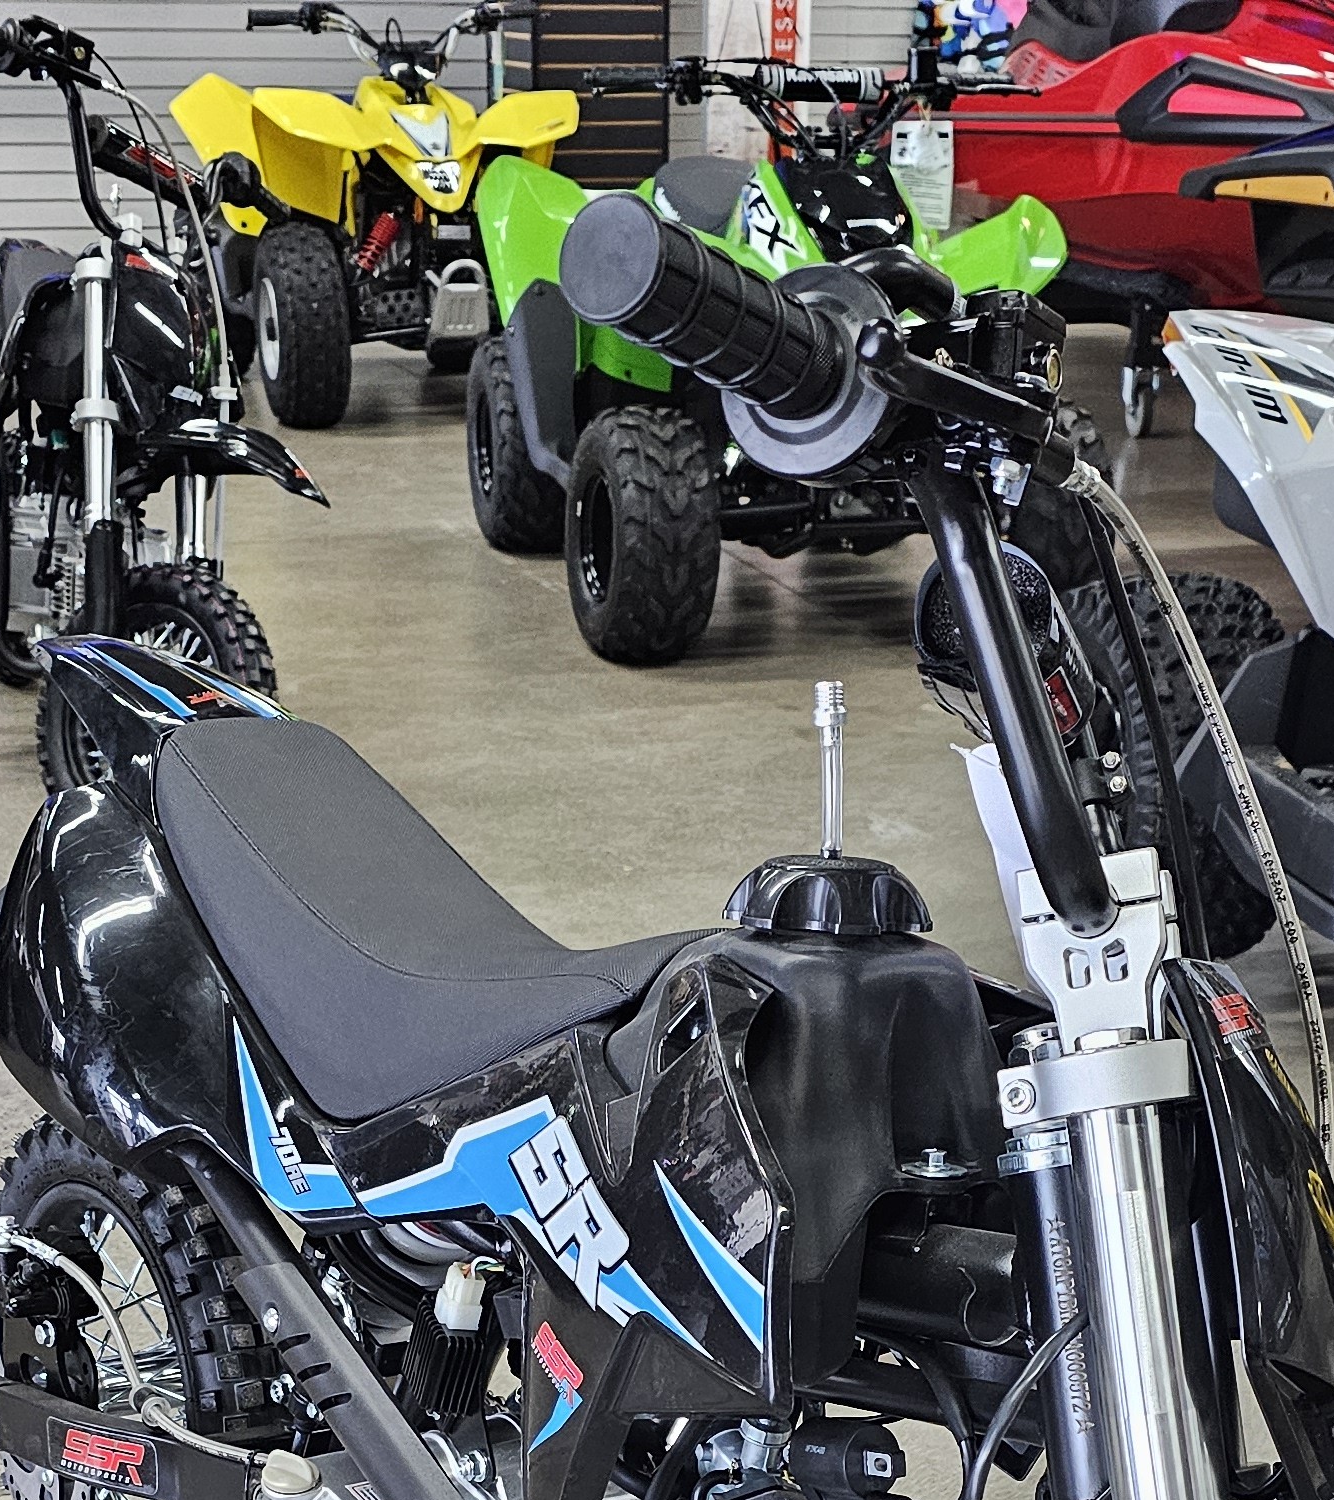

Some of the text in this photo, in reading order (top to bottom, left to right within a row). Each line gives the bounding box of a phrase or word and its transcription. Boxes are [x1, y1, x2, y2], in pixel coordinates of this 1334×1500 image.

[268, 1126, 312, 1196] 70RE
[508, 1114, 630, 1313] SR
[534, 1320, 585, 1410] SSR
[60, 1458, 131, 1485] MOTORSPORTS
[62, 1428, 143, 1487] SSR
